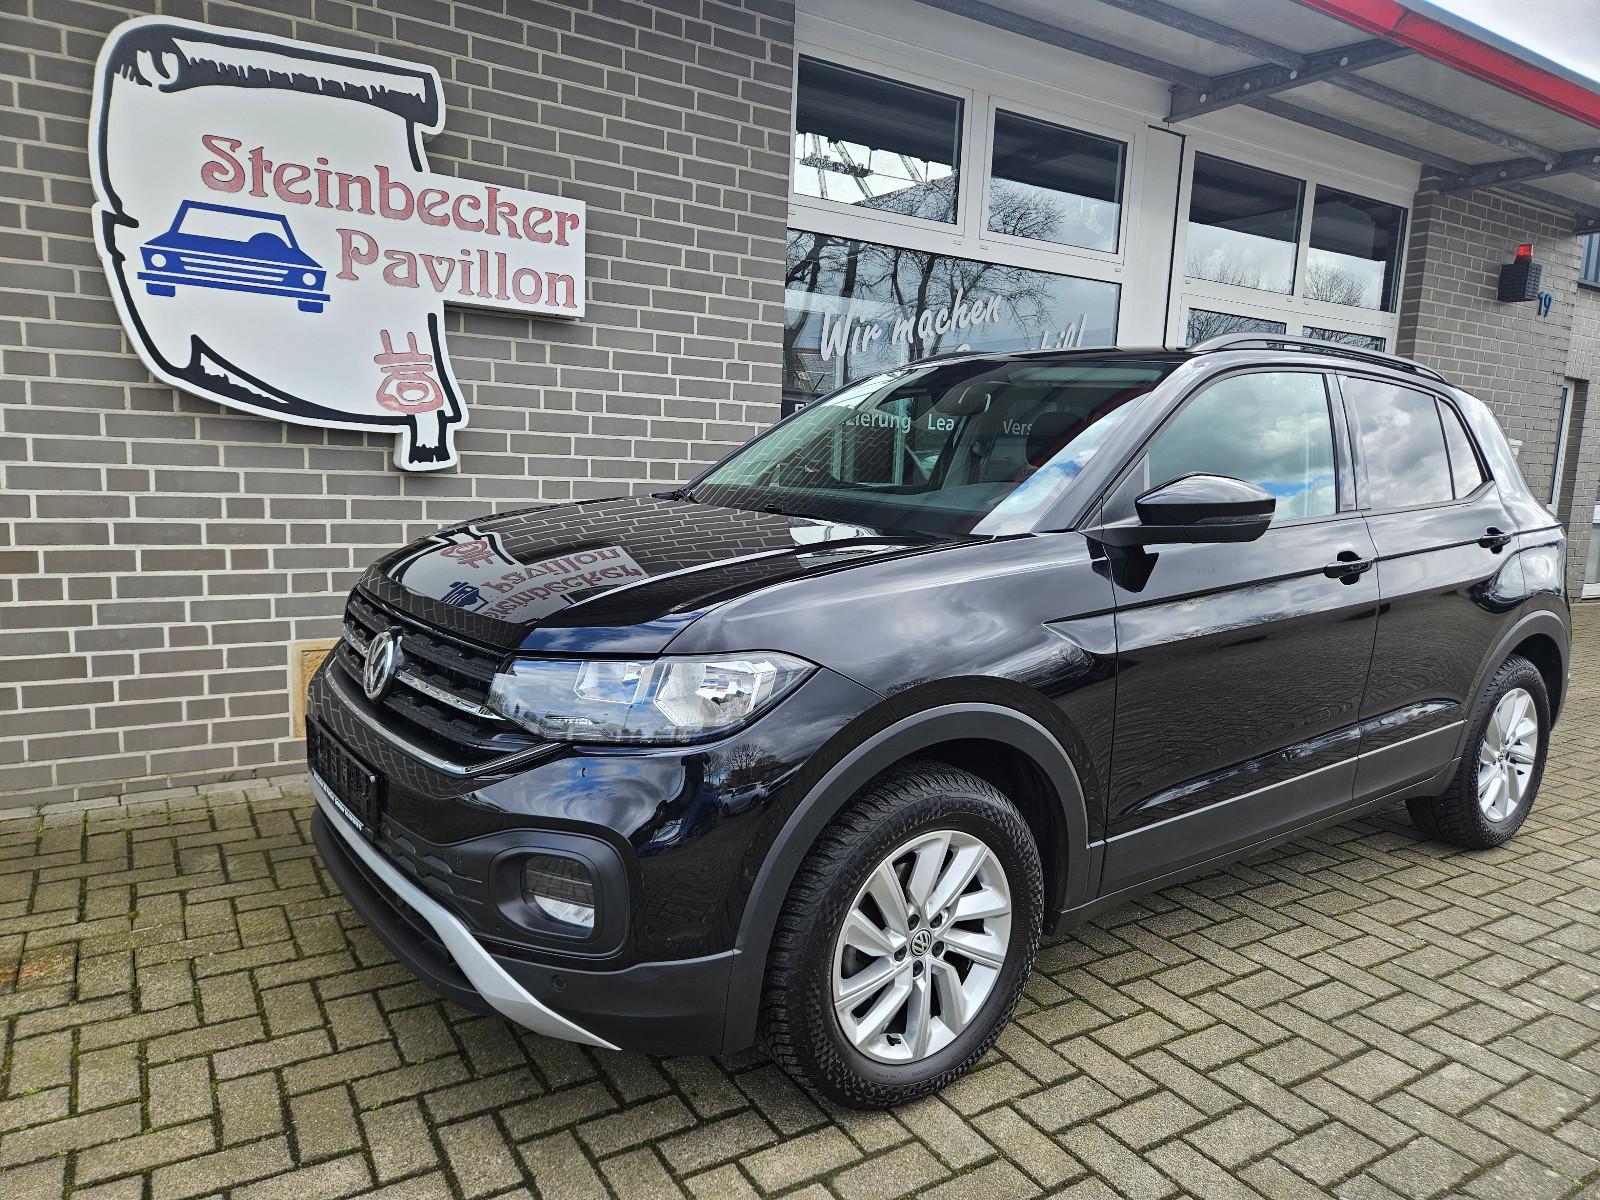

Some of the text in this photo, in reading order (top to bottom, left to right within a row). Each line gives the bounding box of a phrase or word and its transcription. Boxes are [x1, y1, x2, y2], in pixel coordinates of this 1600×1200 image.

[201, 134, 580, 247] Steinbecker
[335, 227, 578, 309] Pavillon
[1537, 291, 1552, 317] 19
[821, 303, 882, 361] Wir
[892, 287, 1001, 345] machen
